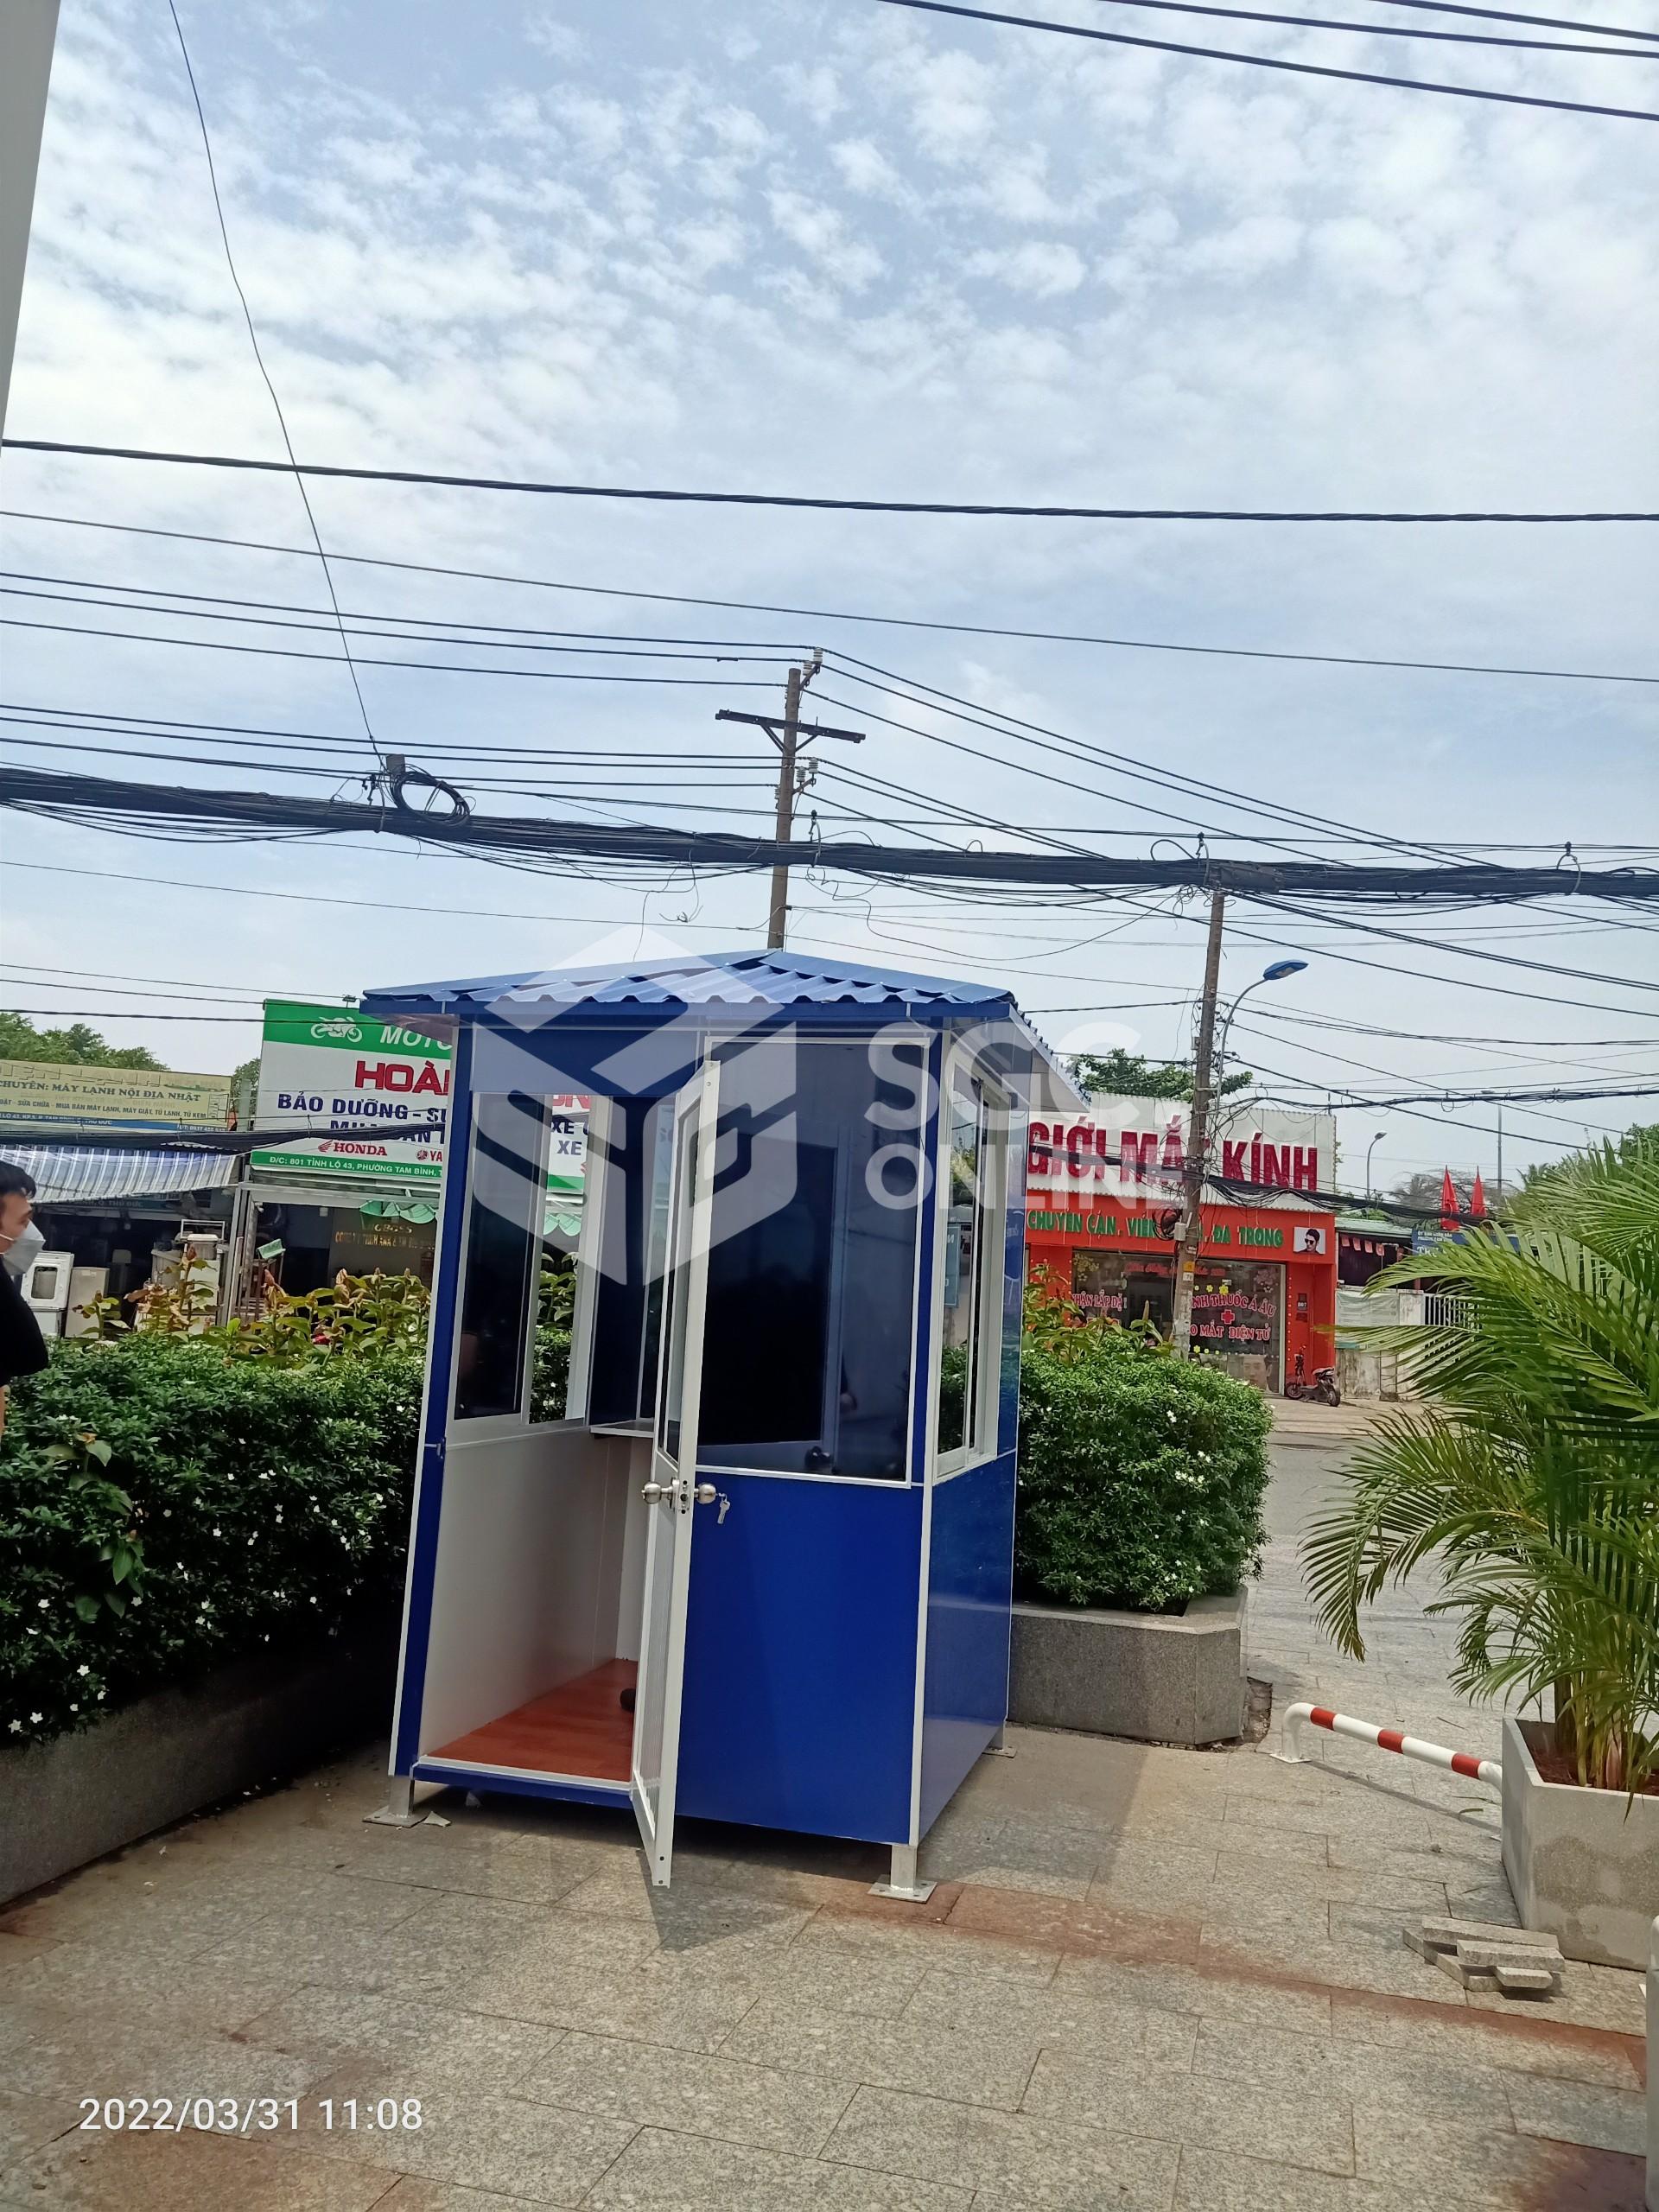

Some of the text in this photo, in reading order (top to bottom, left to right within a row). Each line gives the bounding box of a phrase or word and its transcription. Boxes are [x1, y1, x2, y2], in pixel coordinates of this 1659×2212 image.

[354, 1060, 450, 1096] HOÀ
[52, 1083, 79, 1092] MÁY
[83, 1085, 115, 1096] LẠNH
[118, 1088, 140, 1098] NỘI
[168, 1091, 200, 1102] NHẬT
[277, 1090, 323, 1112] BẢO
[332, 1098, 408, 1120] DƯỠNG
[333, 1142, 388, 1156] HONDA
[557, 1140, 582, 1155] XE
[1027, 1115, 1319, 1192] GIỚI MẮ KÍNH
[307, 1158, 327, 1167] TỈNH
[329, 1160, 340, 1169] LỘ
[357, 1163, 392, 1173] PHƯỜNG
[414, 1166, 436, 1176] BÌNH,
[1210, 1289, 1249, 1308] THUỐC
[1190, 1324, 1198, 1337] O
[1228, 1324, 1255, 1341] ĐIỆN
[1255, 1323, 1271, 1341] TỬ
